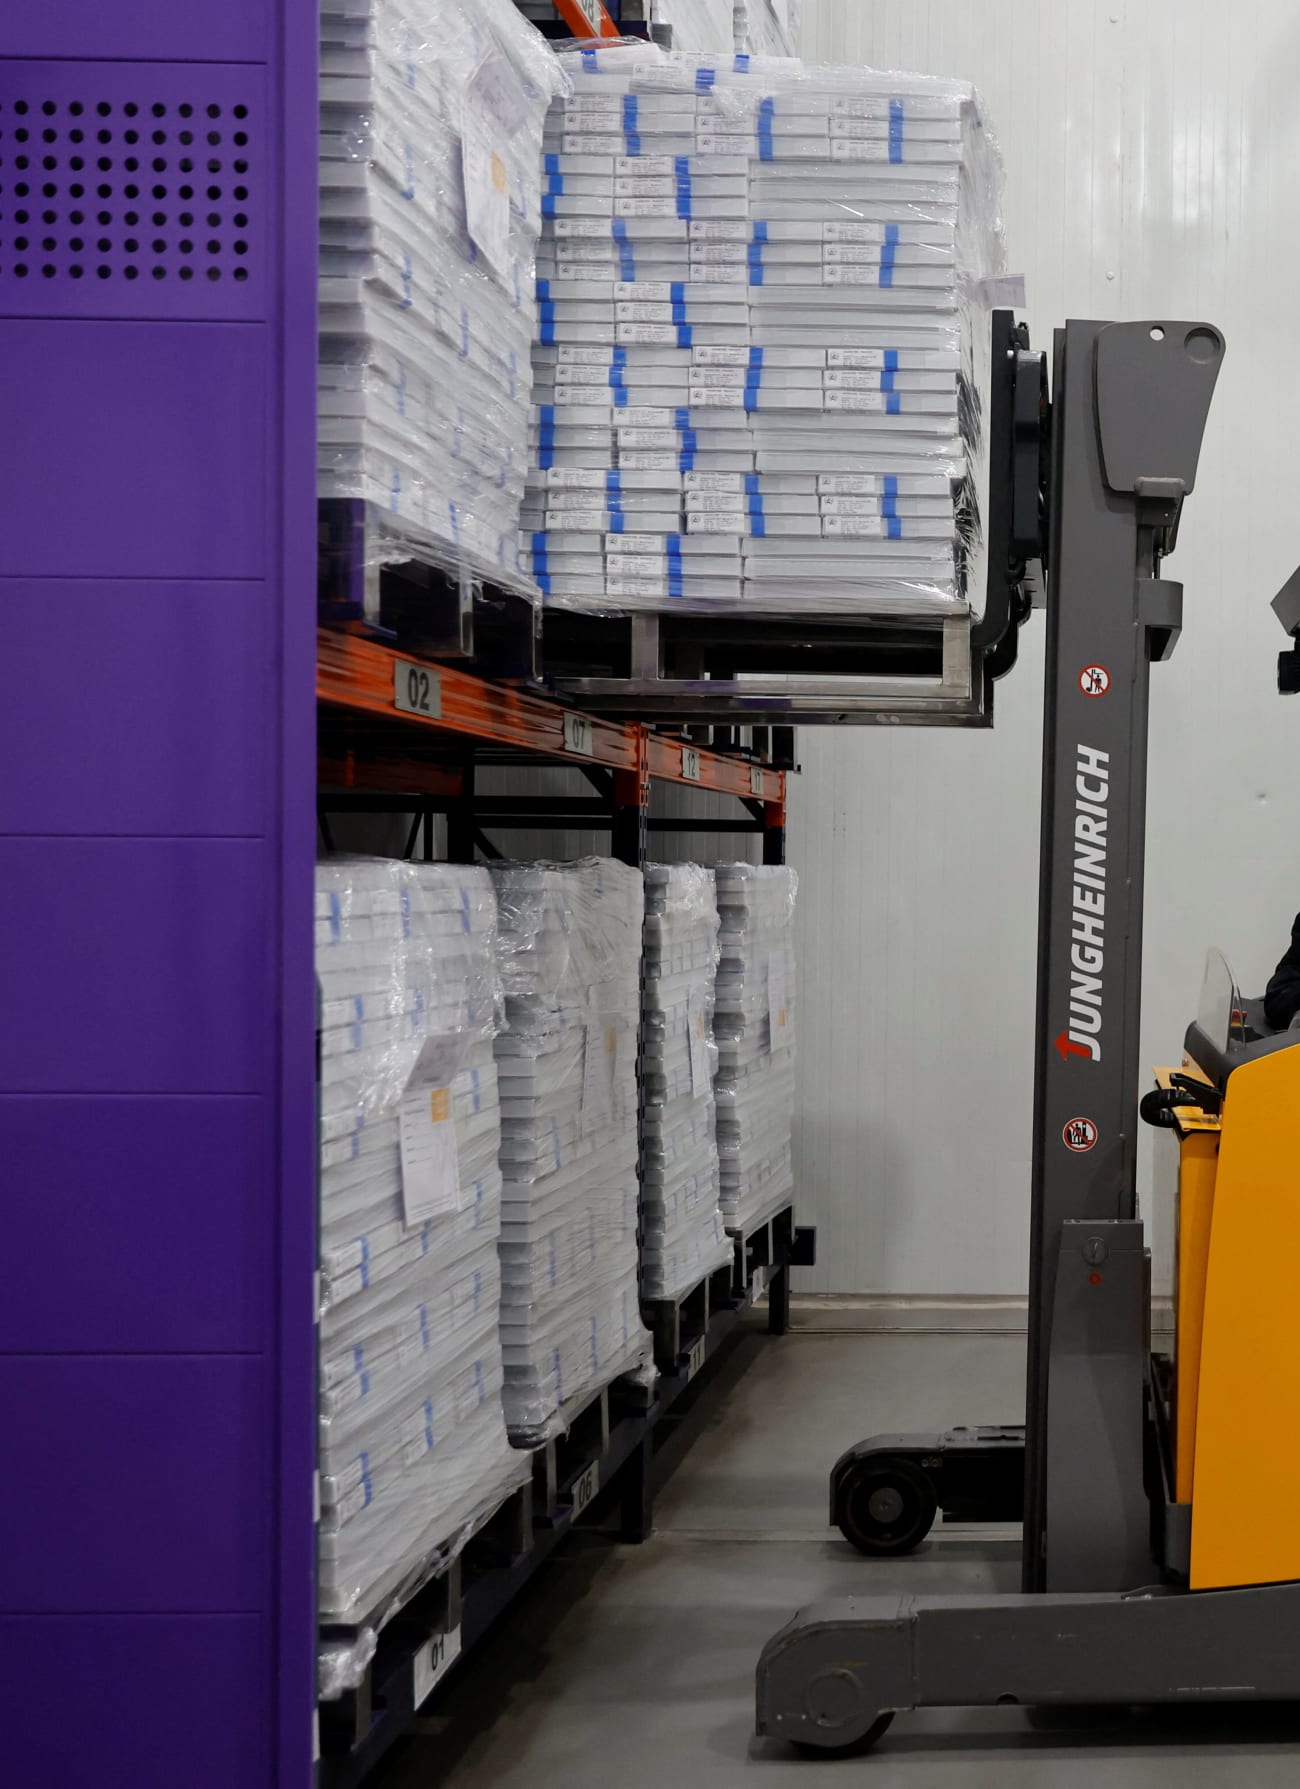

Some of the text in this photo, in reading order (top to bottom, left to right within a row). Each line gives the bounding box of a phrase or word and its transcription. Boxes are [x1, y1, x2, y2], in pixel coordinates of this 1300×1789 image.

[408, 668, 430, 711] 02
[572, 718, 586, 750] 07
[687, 752, 696, 777] 12
[1066, 743, 1110, 1063] JUNGHEINRICH
[579, 1470, 592, 1508] 06
[431, 1632, 445, 1671] 01
